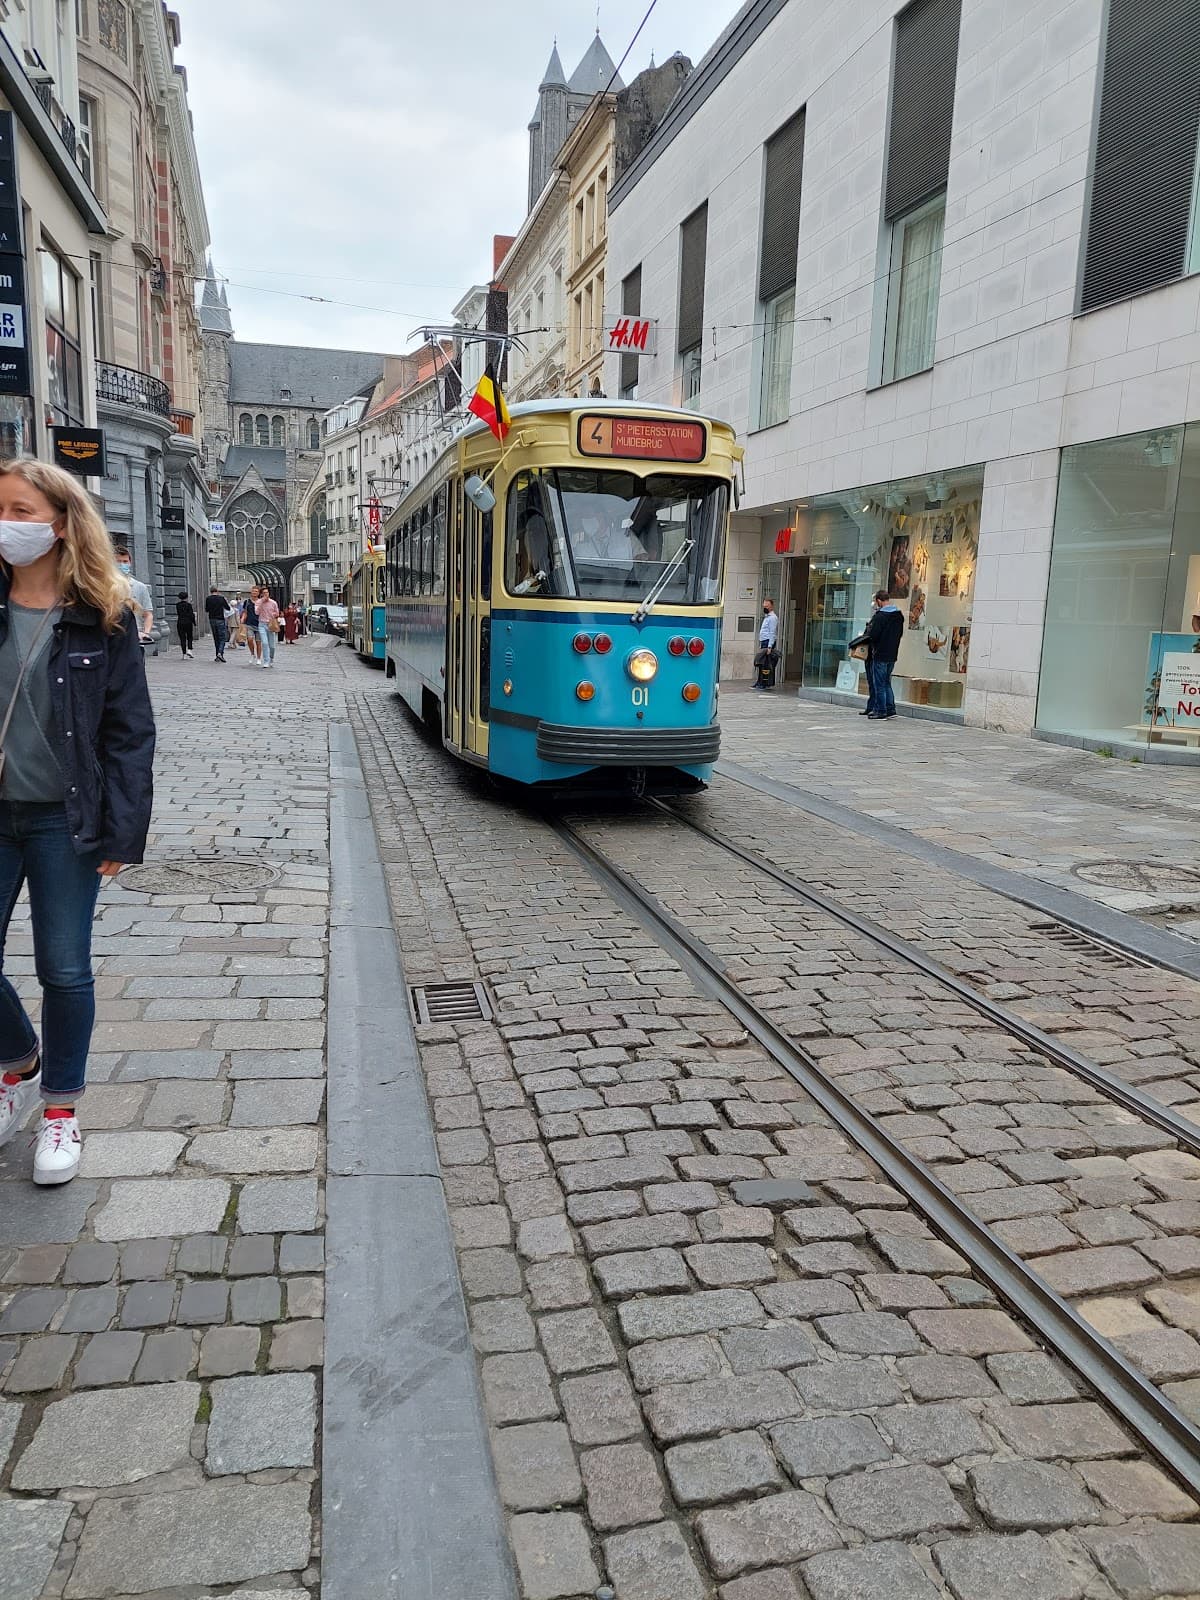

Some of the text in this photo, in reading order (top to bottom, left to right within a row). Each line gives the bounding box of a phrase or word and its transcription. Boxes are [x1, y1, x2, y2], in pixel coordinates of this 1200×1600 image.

[609, 318, 649, 350] H&M
[590, 421, 603, 444] 4
[627, 425, 693, 438] PIETERSSTATION
[616, 437, 663, 448] MUIDEBRUG
[631, 687, 649, 706] 01
